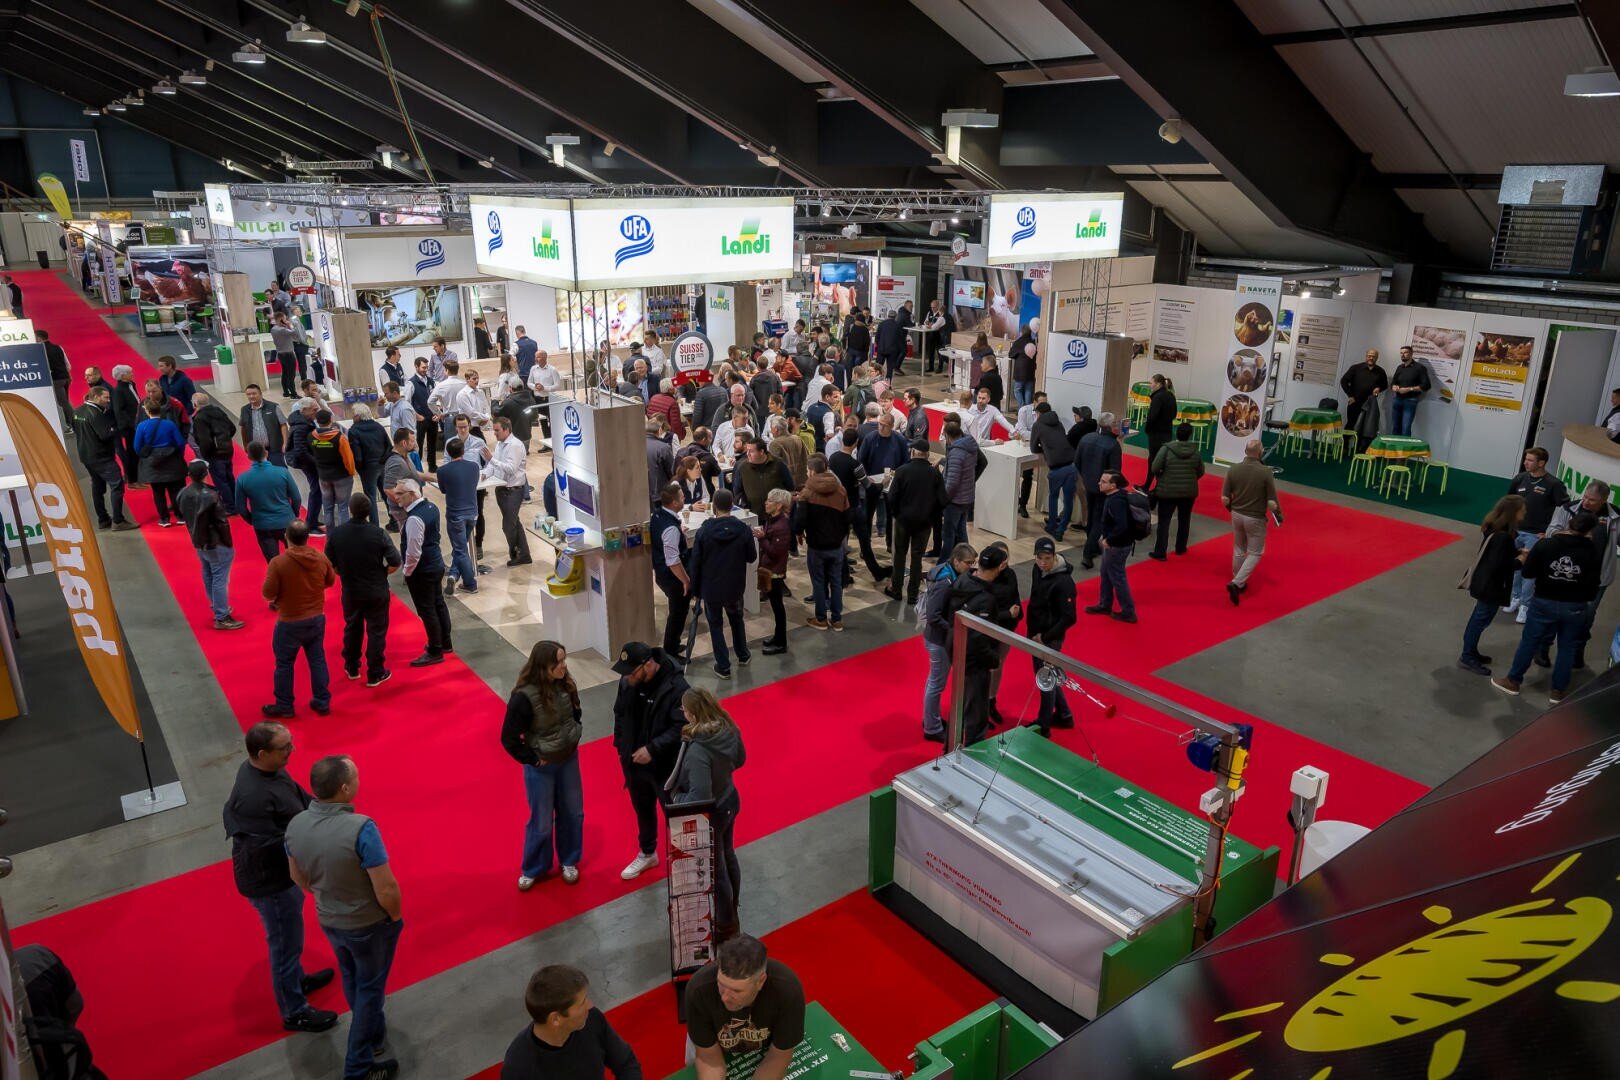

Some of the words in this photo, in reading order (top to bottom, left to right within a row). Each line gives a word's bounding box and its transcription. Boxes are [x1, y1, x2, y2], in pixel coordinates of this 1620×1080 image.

[488, 212, 501, 231] UFA
[1018, 208, 1035, 225] UFA
[623, 216, 649, 238] UFA
[1075, 221, 1107, 239] Landi
[421, 241, 442, 256] UFA
[533, 237, 560, 261] Landi
[722, 234, 771, 256] Landi
[1247, 286, 1277, 294] NAVETA
[710, 295, 730, 311] Landi
[0, 332, 28, 343] OLA
[679, 342, 704, 354] SUISSE
[1069, 341, 1085, 355] UFA
[13, 360, 28, 370] da
[680, 354, 695, 364] TIER
[1482, 365, 1517, 377] ProLacto
[1556, 460, 1620, 507] NAVT
